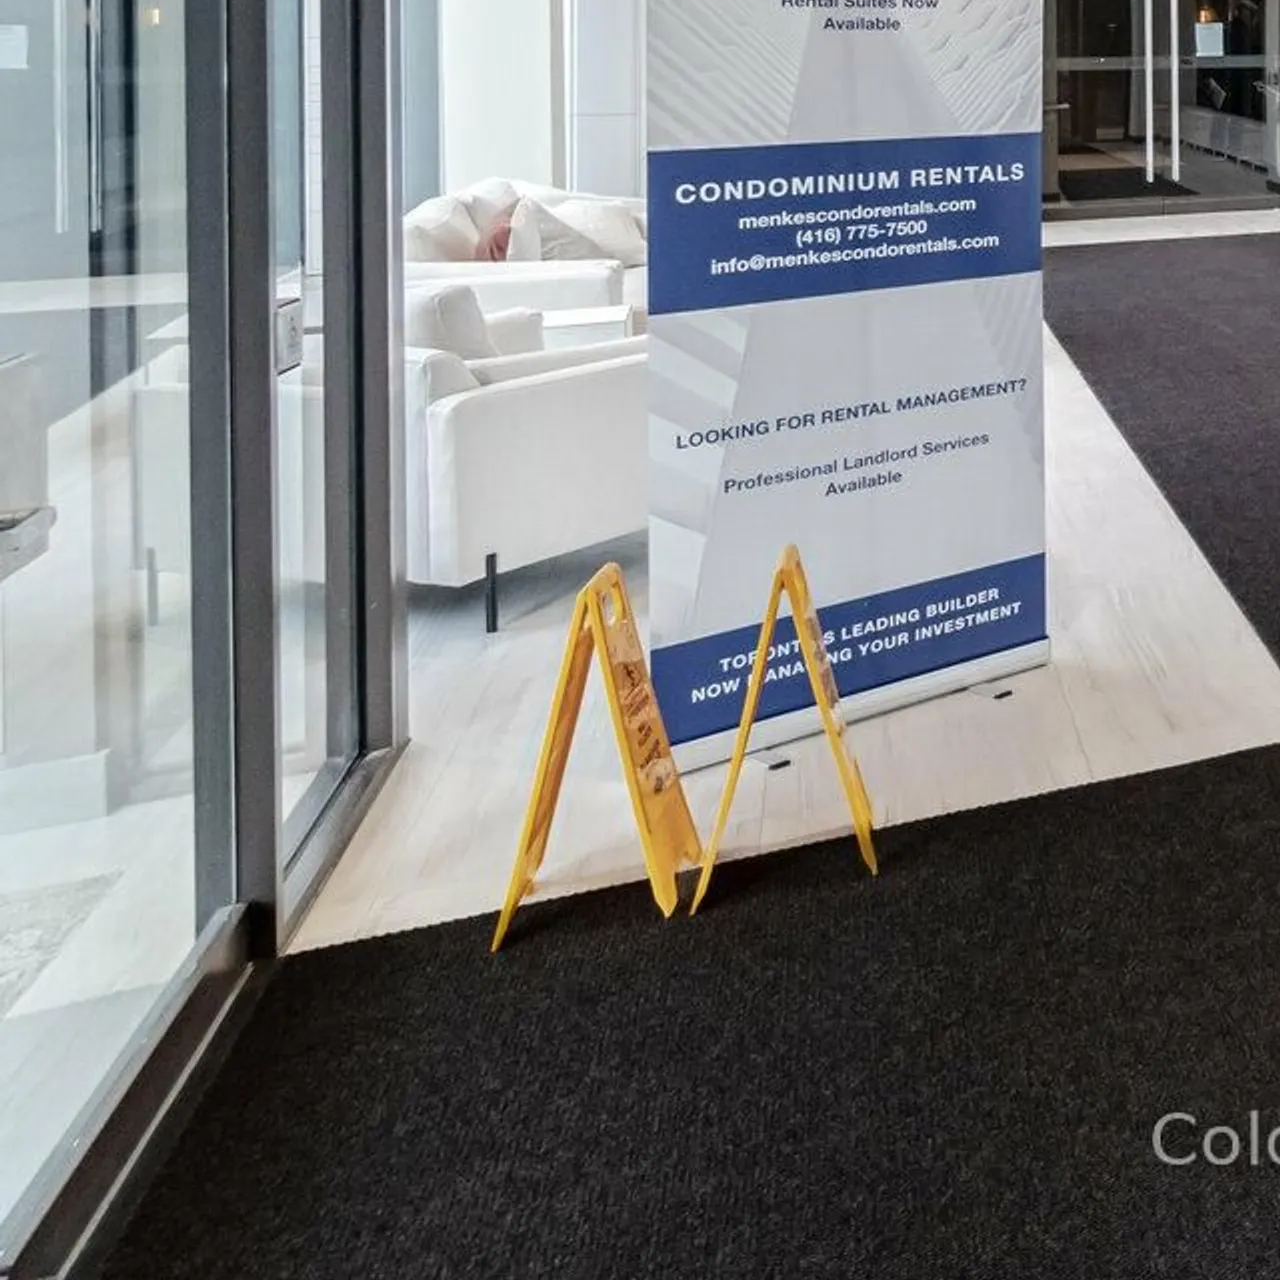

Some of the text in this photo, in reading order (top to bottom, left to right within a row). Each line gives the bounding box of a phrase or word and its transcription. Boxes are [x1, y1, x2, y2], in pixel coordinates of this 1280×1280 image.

[823, 17, 901, 32] Available
[675, 162, 1025, 204] CONDOMINIUM RENTALS
[738, 198, 976, 229] menkescondorentals.com
[796, 220, 928, 248] (416) 775-7500
[710, 235, 1000, 275] info@menkescondorentals.com
[675, 377, 1027, 450] LOOKING FOR RENTAL MANAGEMENT?
[723, 431, 990, 494] Professional Landlord Services
[825, 471, 903, 497] Available
[841, 609, 921, 640] LEADING
[925, 586, 1000, 617] BUILDER
[690, 678, 741, 703] NOW
[858, 632, 909, 660] YOUR
[915, 601, 1022, 641] INVESTMENT
